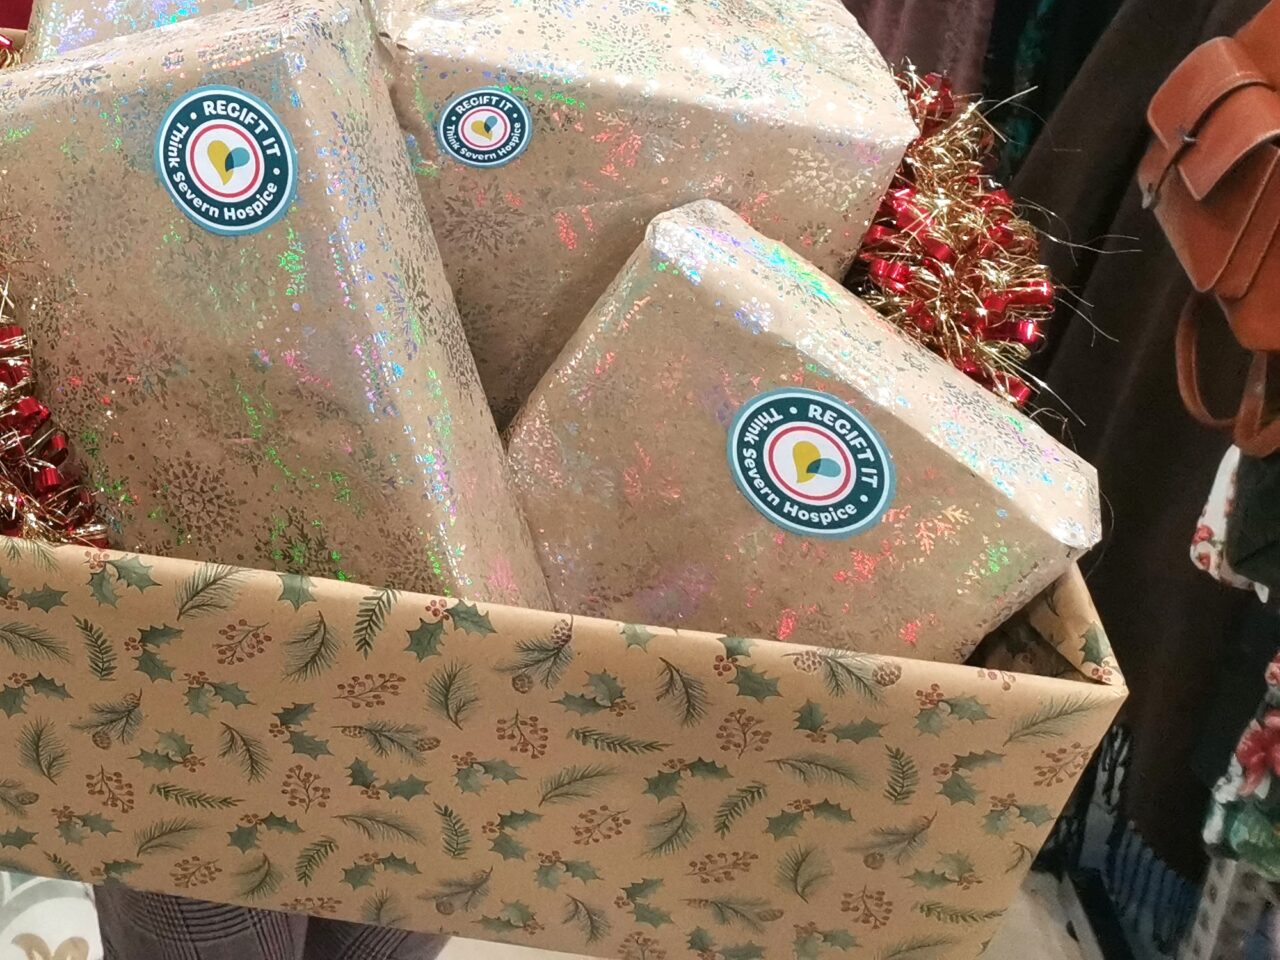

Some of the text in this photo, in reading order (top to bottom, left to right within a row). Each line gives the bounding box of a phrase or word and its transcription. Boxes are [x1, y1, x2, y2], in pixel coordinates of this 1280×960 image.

[203, 100, 281, 157] REGIFT IT
[455, 95, 513, 114] REGIFT IT
[168, 122, 278, 220] Think Severn Hospice
[446, 122, 521, 160] Think Severn Hospice
[742, 407, 858, 526] Think Severn Hospice
[808, 404, 878, 488] REGIFT IT
